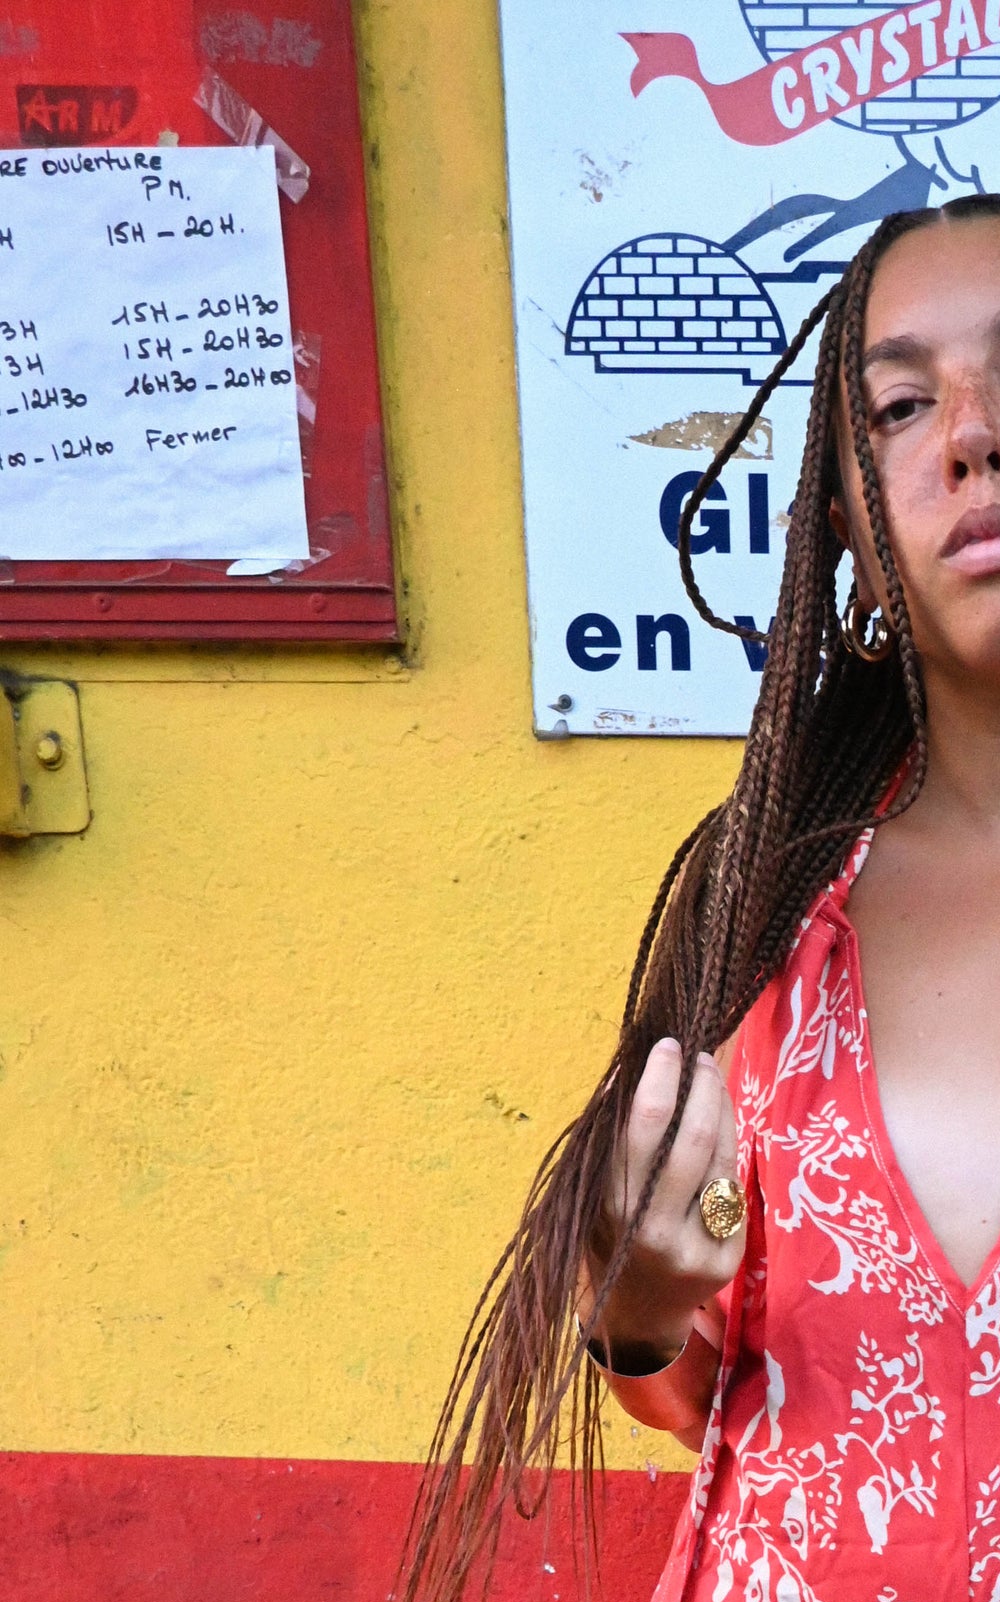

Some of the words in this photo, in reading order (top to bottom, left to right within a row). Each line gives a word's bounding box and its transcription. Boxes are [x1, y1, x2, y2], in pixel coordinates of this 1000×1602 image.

[0, 353, 45, 377] 3H
[145, 426, 237, 452] Fermer
[566, 612, 691, 672] en
